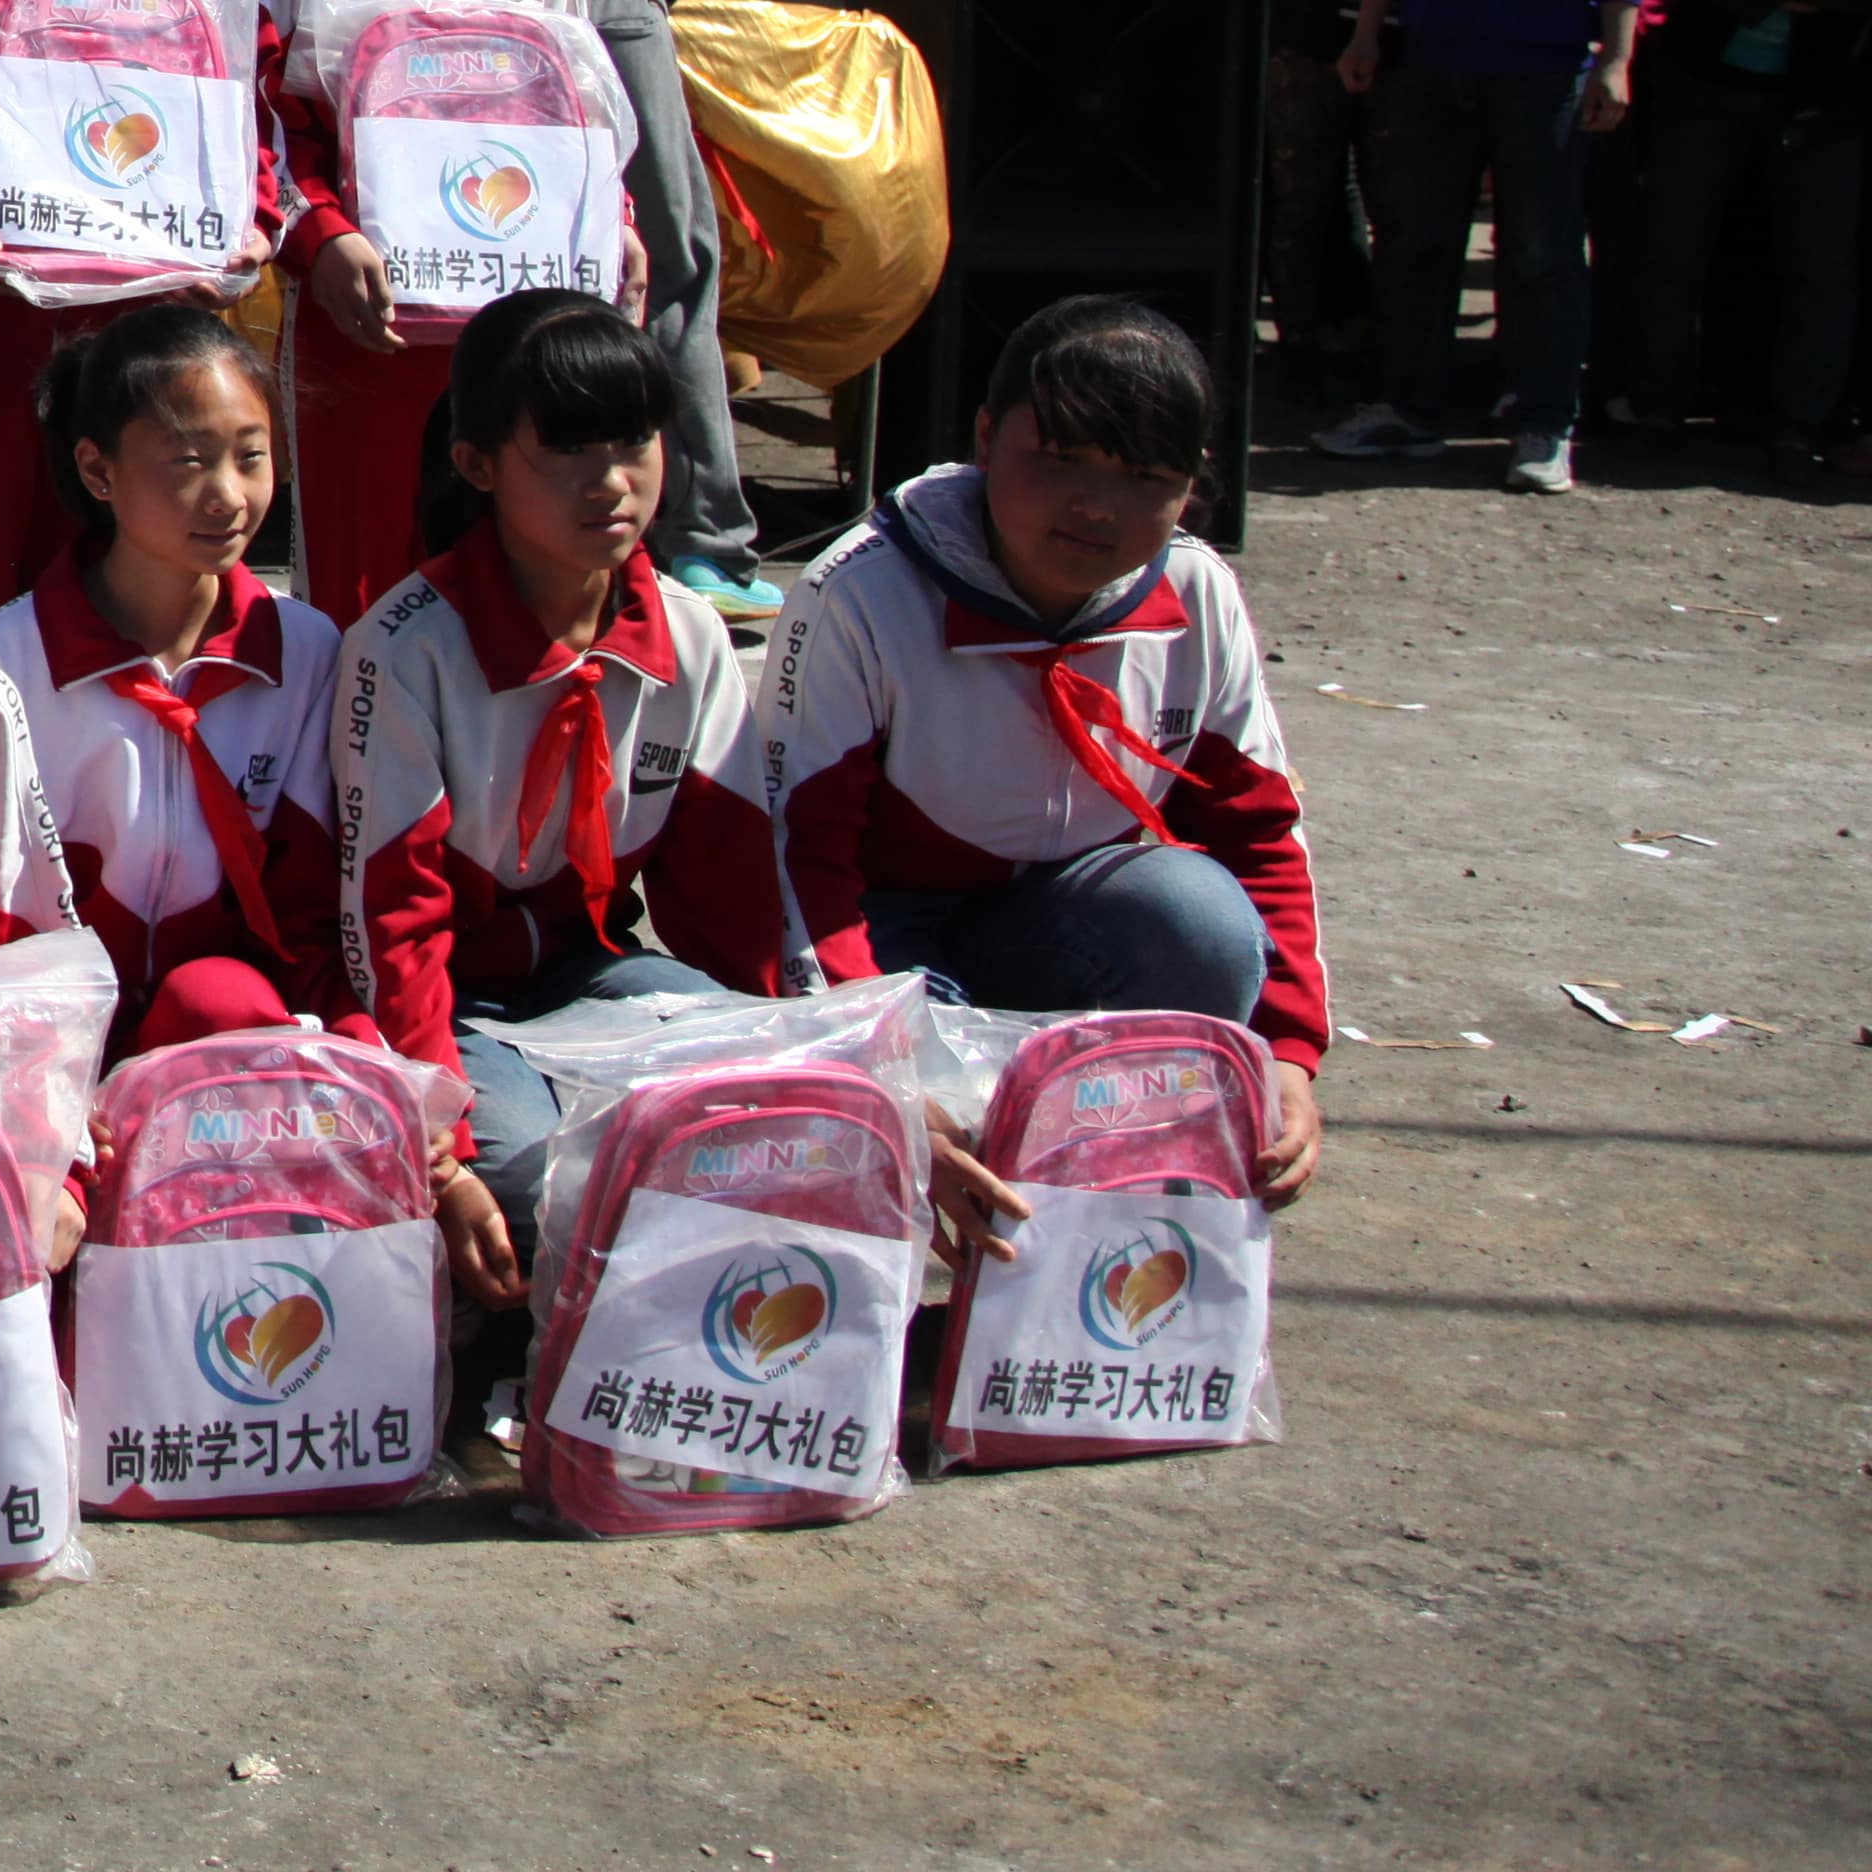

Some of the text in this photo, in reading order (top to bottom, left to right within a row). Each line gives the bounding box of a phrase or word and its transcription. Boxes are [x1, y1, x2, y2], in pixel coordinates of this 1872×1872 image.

[383, 246, 602, 297] 尚赫学习大礼包
[378, 581, 441, 637] PORT
[808, 535, 885, 597] SPORT
[349, 656, 377, 758] SPORT
[777, 620, 807, 716] SPORT
[636, 740, 689, 776] SPORT
[27, 775, 64, 863] SPORT
[339, 783, 363, 882] SPORT
[339, 911, 370, 1002] SPORT
[581, 1367, 869, 1478] 尚赫学习大礼包
[978, 1357, 1236, 1423] 尚赫学习大礼包
[105, 1402, 412, 1488] 尚赫学习大礼包
